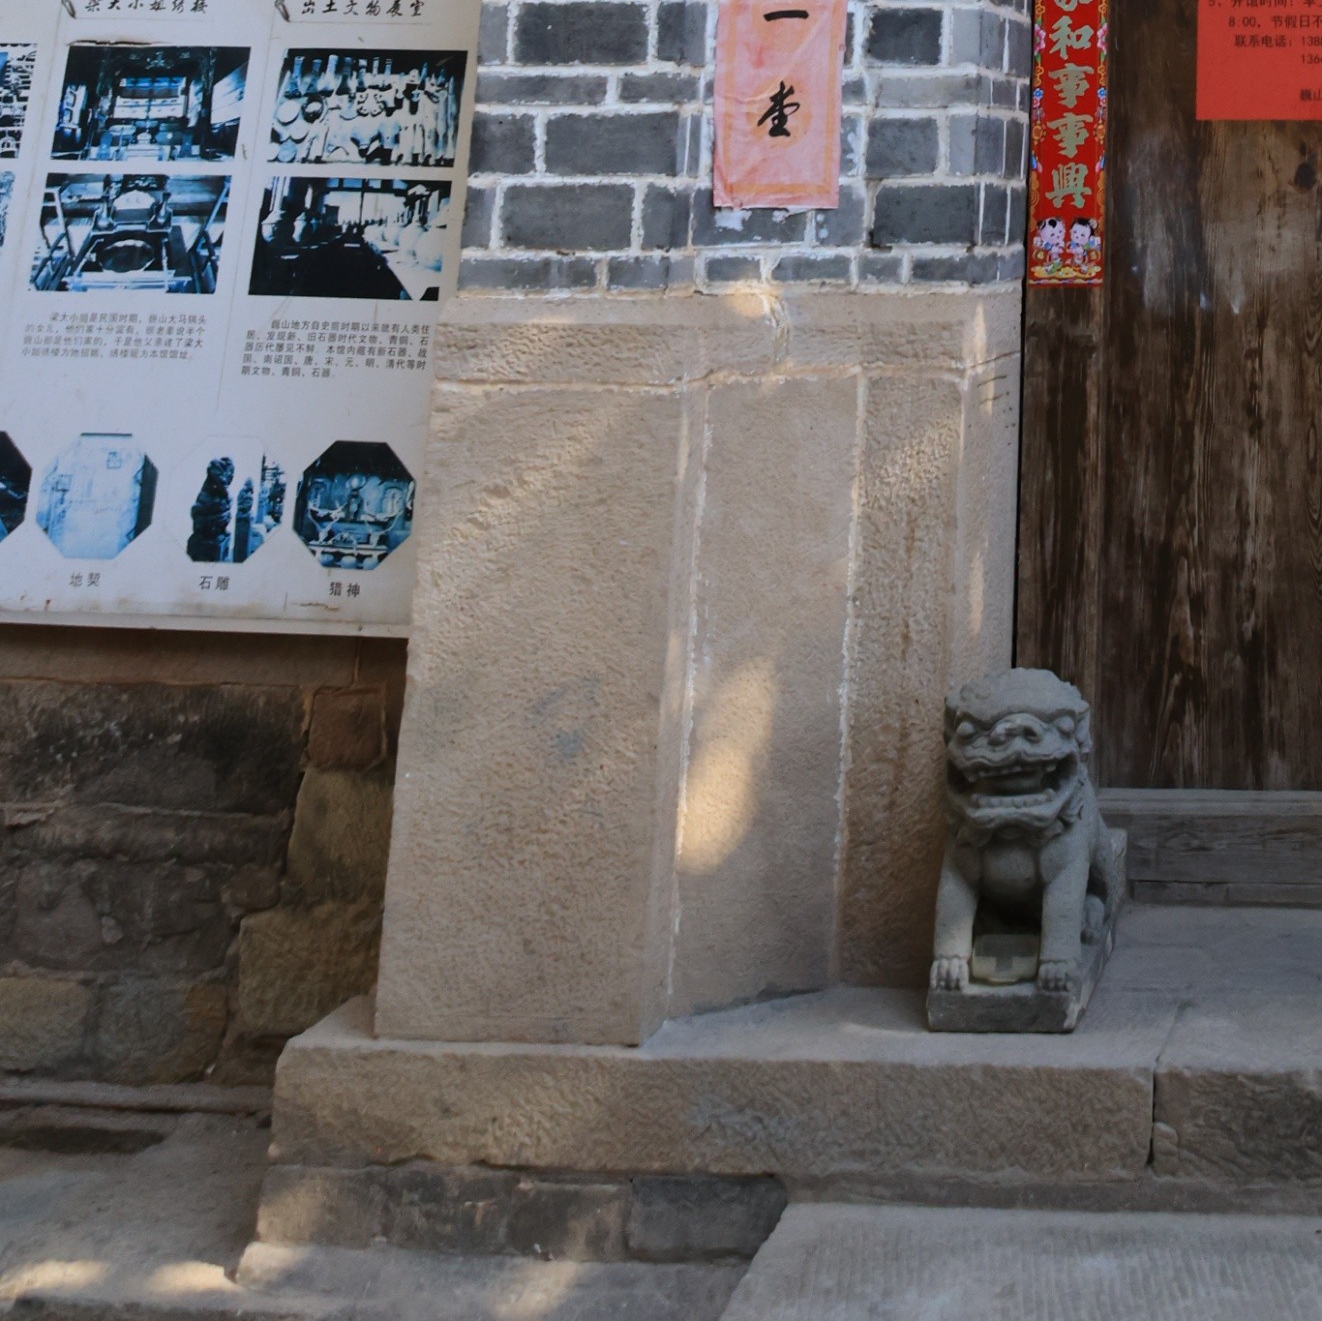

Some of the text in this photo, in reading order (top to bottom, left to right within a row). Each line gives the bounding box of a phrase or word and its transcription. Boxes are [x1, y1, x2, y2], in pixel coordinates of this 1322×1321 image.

[69, 572, 101, 588] 地契
[199, 575, 230, 591] 石雕
[329, 581, 360, 598] 猎神
